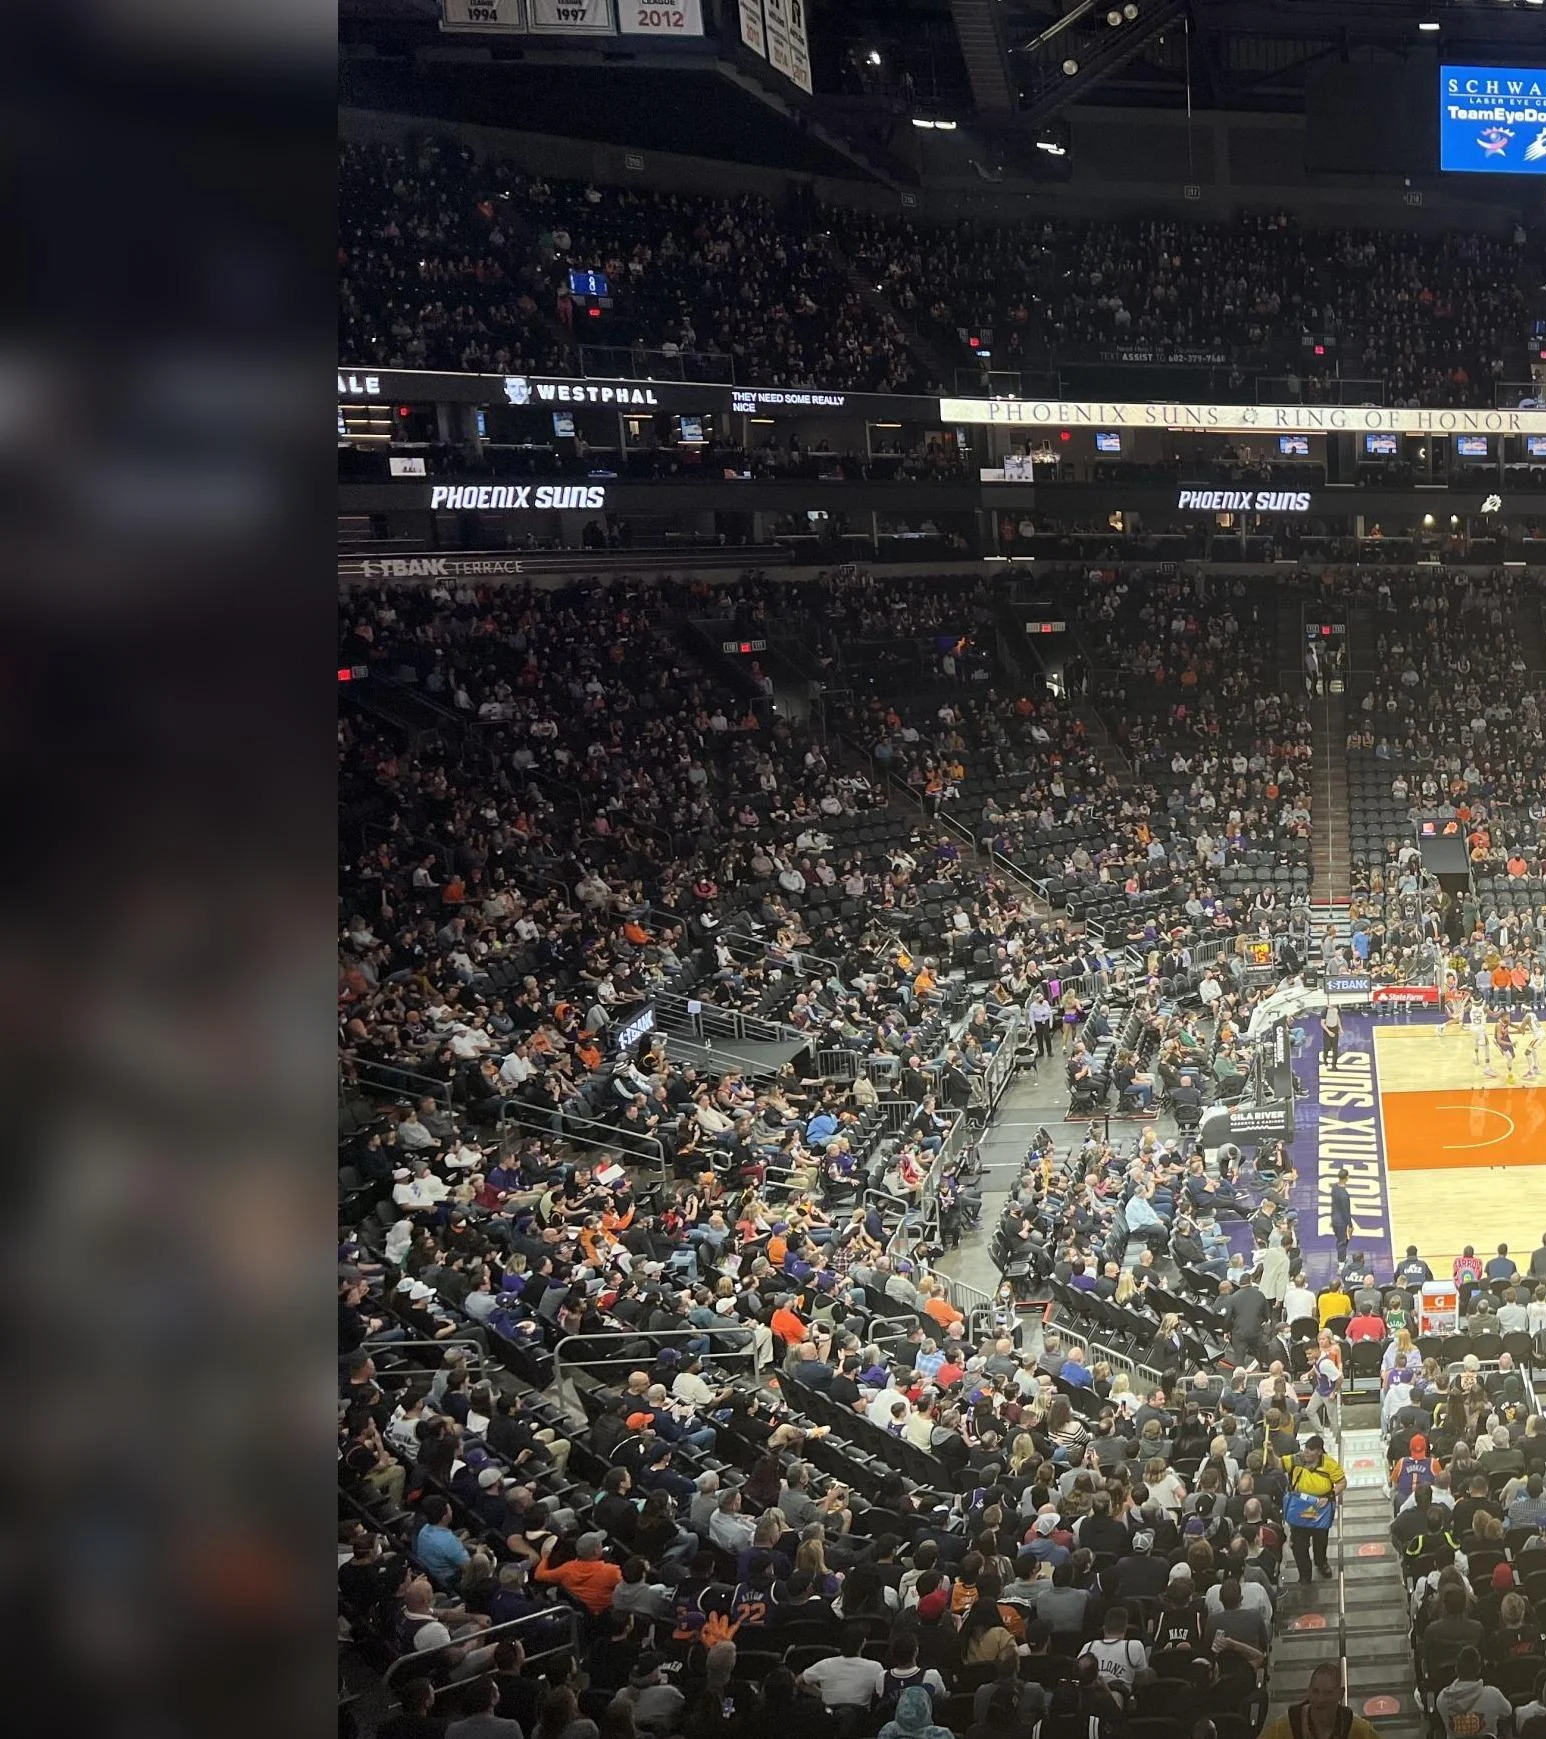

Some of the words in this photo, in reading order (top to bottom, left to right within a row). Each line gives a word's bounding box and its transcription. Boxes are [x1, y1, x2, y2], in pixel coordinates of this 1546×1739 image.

[468, 8, 498, 22] 1994
[556, 7, 587, 21] 1997
[637, 10, 684, 27] 2012
[1122, 353, 1153, 361] ASSIST
[537, 384, 658, 404] WESTPHAL
[732, 392, 757, 403] THEY
[759, 393, 783, 404] NEED
[784, 394, 811, 405] SOME
[812, 395, 845, 406] REALLY
[733, 402, 756, 413] NICE
[988, 402, 1127, 424] PHOENIX
[1146, 405, 1219, 426] SUNS
[1275, 408, 1346, 428] RING
[1364, 410, 1400, 428] OF
[1417, 411, 1521, 431] HONOR
[431, 485, 531, 508] PHOENIX
[535, 486, 605, 509] SUNS
[1179, 491, 1253, 510] PHOENIX
[1255, 492, 1311, 511] SUNS
[455, 561, 524, 575] TERRACE
[1255, 953, 1266, 964] 15
[1319, 1051, 1375, 1108] SUNS
[1230, 1113, 1254, 1121] GILA
[1254, 1111, 1285, 1120] RIVER
[1318, 1115, 1385, 1238] PHOENIX
[1434, 1296, 1445, 1307] G
[1406, 1465, 1427, 1474] BOOKER
[741, 1592, 764, 1603] AYTON
[738, 1603, 768, 1625] 22
[1169, 1629, 1189, 1641] NASH
